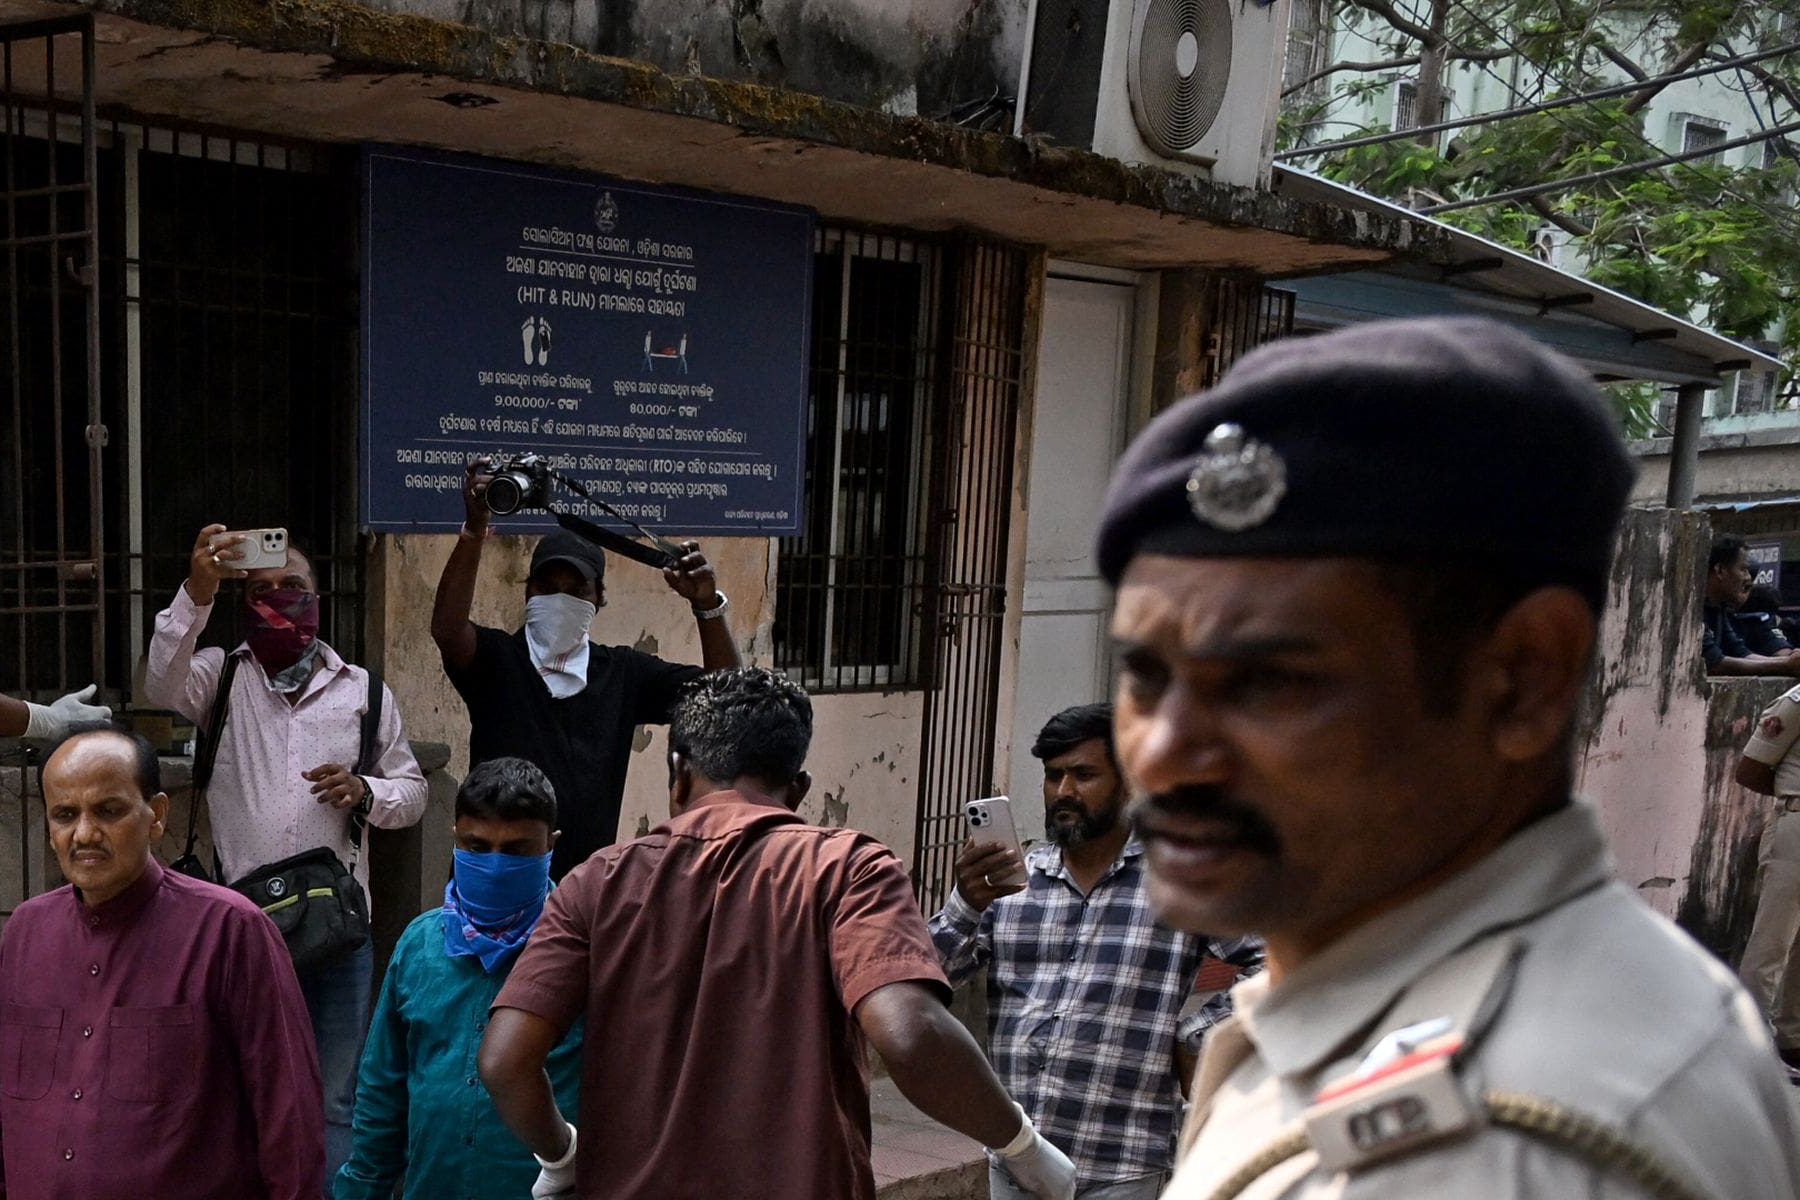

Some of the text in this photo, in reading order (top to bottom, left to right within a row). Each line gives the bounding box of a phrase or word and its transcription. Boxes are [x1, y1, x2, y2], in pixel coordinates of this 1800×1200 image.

[517, 286, 546, 304] (HIT
[549, 288, 558, 305] &
[562, 290, 596, 311] RUN)
